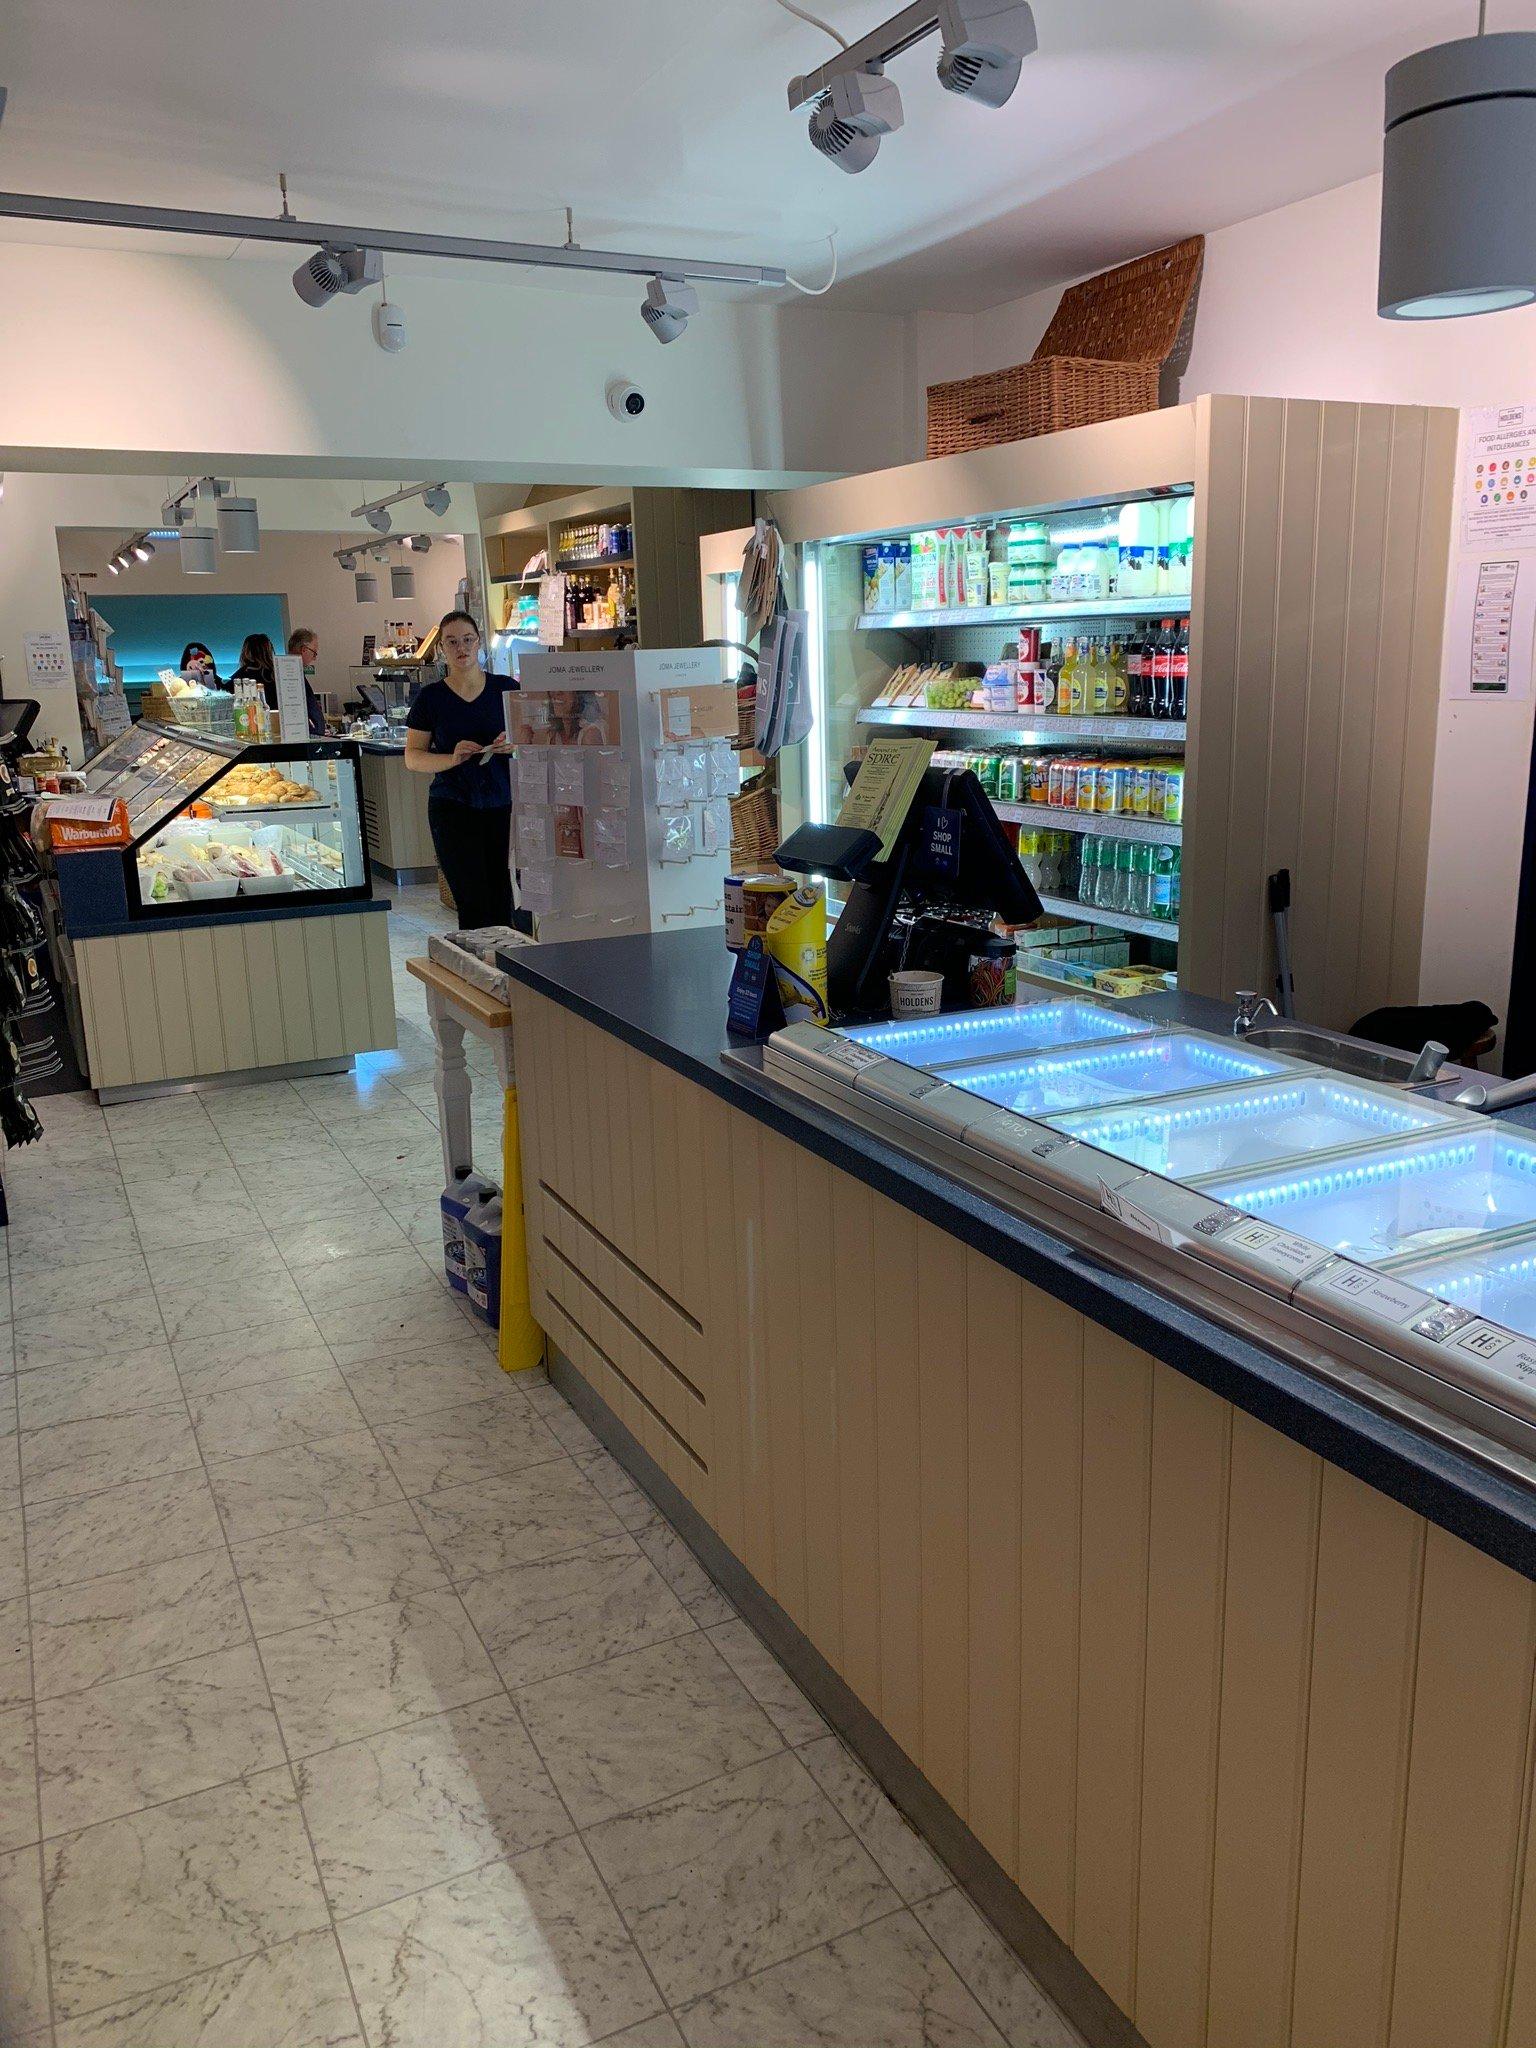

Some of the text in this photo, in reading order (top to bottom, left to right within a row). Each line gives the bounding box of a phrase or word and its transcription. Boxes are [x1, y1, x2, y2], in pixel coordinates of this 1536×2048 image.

[1479, 435, 1496, 443] FOOD
[1496, 430, 1526, 440] ALLERGIES
[1486, 440, 1530, 451] INTOLERANCES
[549, 665, 605, 674] JOMA JEWELLERY
[61, 824, 123, 841] Warburtons
[933, 831, 952, 842] SHOP
[930, 843, 953, 855] SMALL
[900, 996, 934, 1007] HOLDENS
[1244, 1231, 1264, 1243] H
[1341, 1275, 1363, 1287] H
[1371, 1288, 1410, 1309] Strawberry
[1470, 1333, 1494, 1348] H
